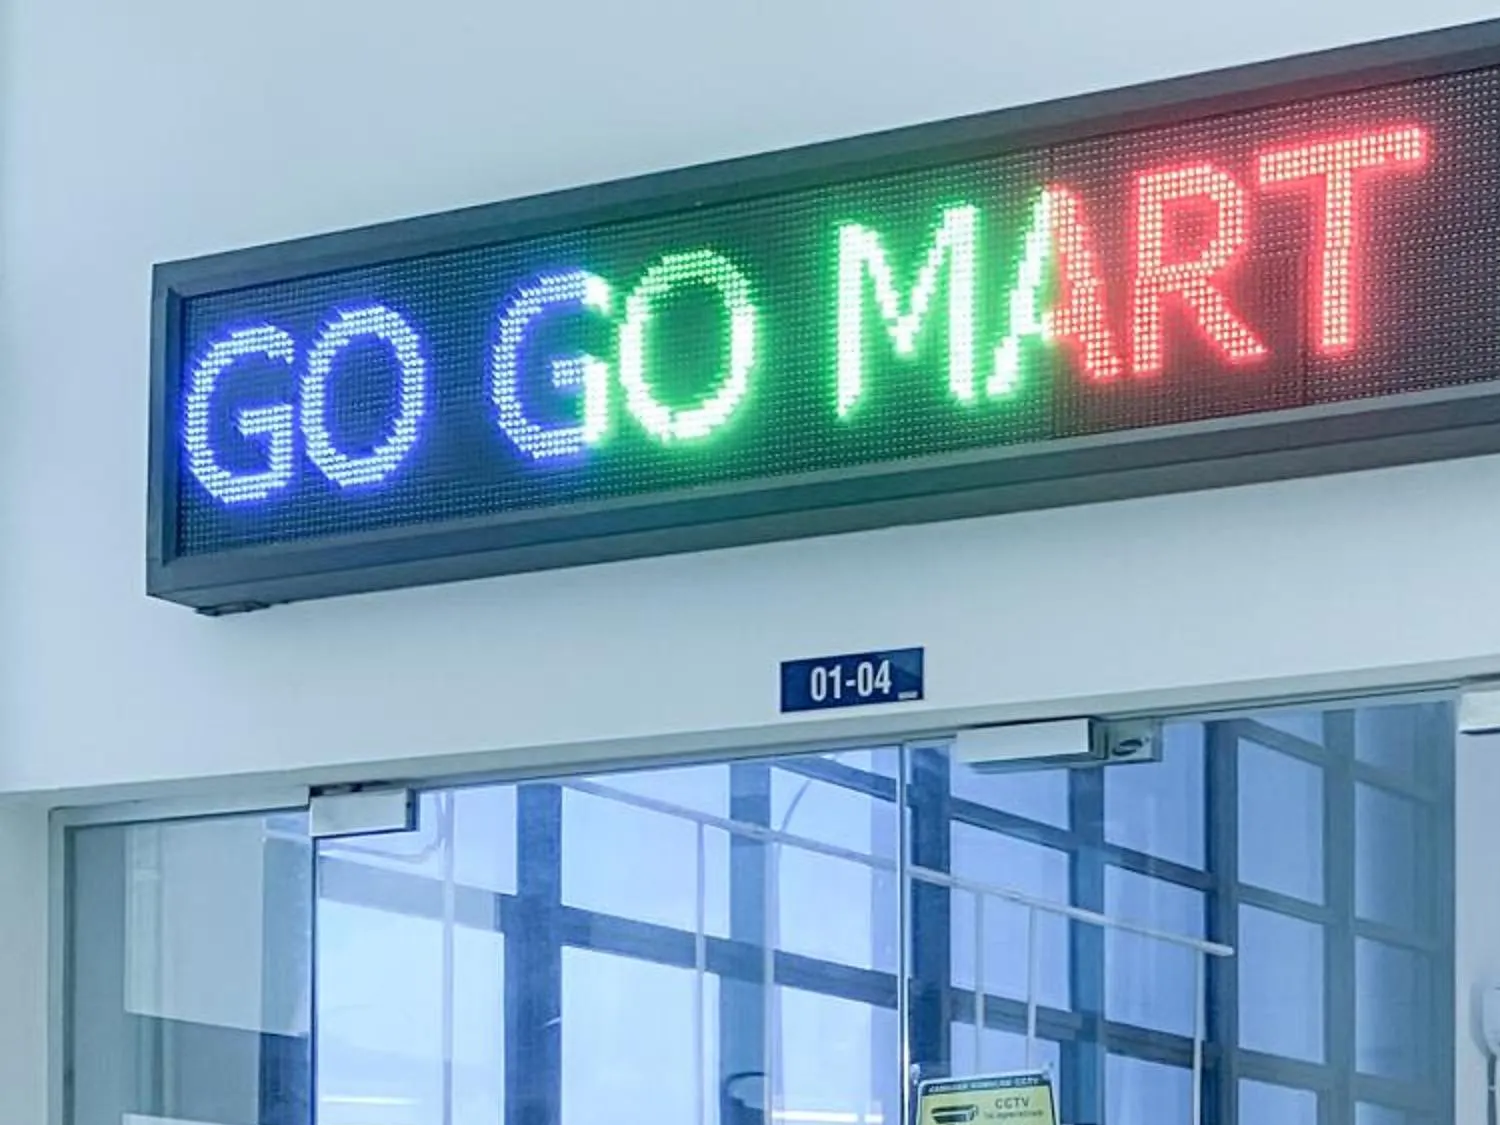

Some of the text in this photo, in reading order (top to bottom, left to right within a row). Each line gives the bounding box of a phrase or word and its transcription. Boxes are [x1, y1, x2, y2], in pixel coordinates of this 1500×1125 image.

[184, 125, 1428, 505] GO GO MART
[811, 659, 892, 701] 01-04
[994, 1097, 1030, 1109] CCTV
